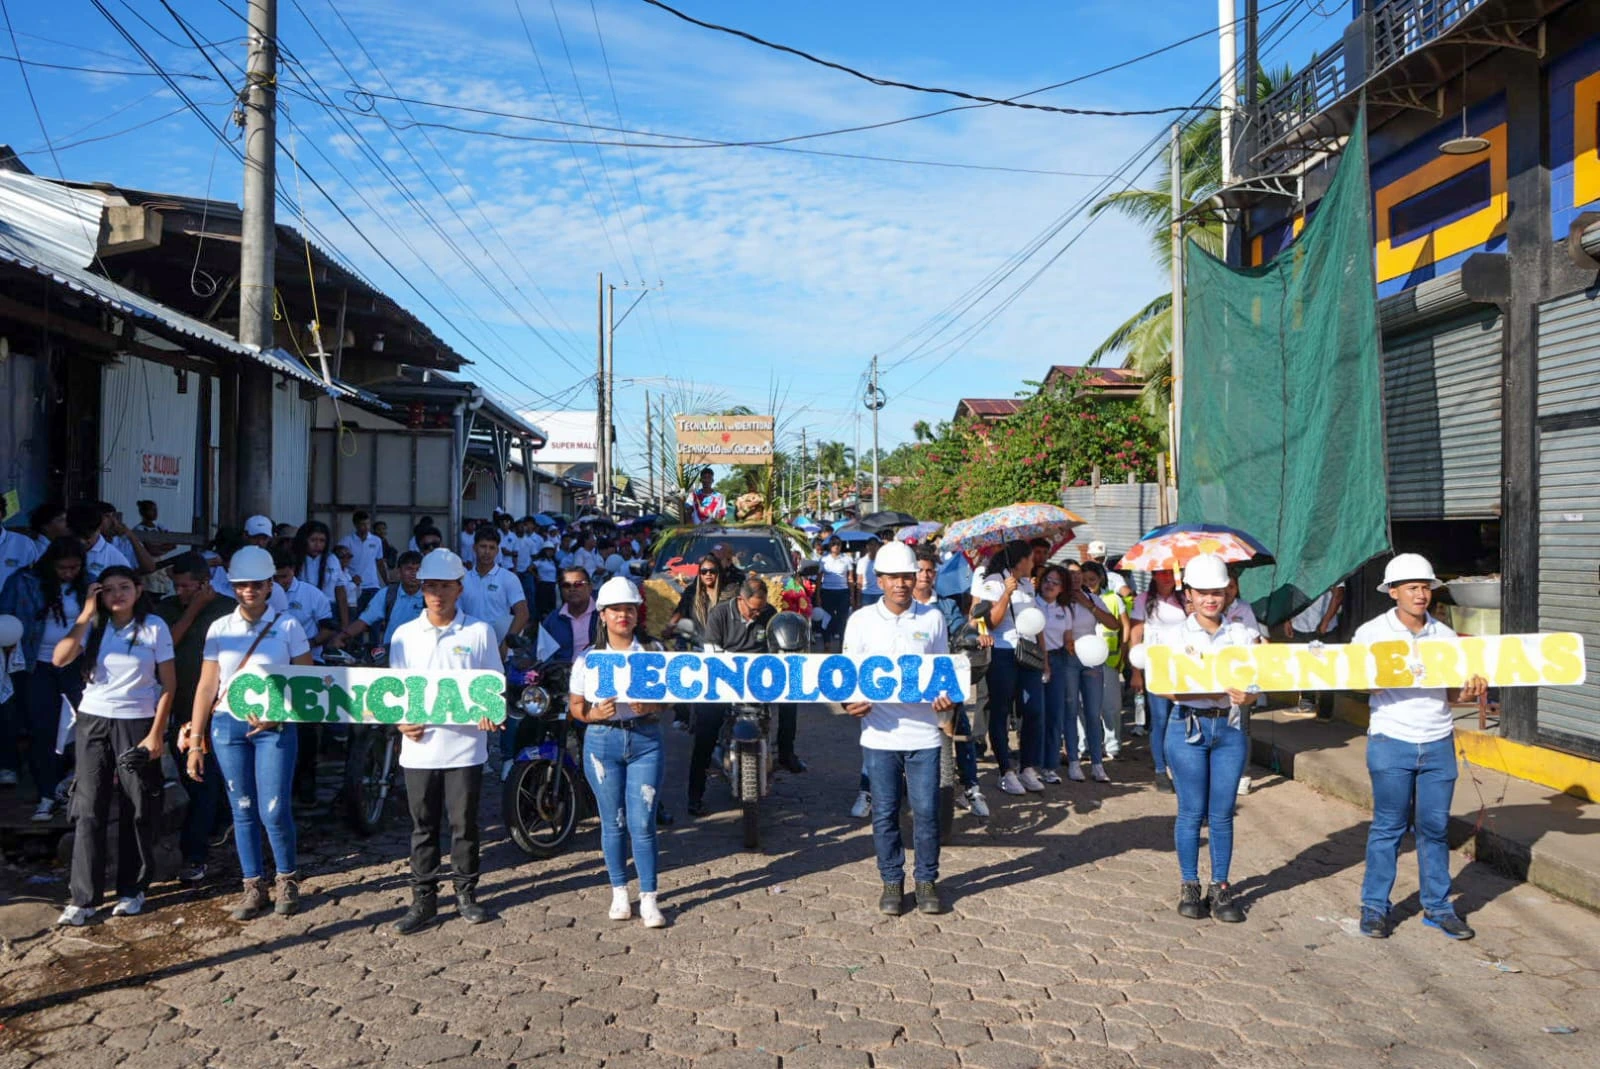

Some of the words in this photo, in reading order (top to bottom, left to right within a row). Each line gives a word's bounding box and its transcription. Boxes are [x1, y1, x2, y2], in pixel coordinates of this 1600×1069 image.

[142, 453, 152, 474] SE
[153, 455, 180, 476] ALQUILA
[551, 441, 576, 449] SUPER
[576, 441, 598, 449] MALL
[585, 652, 965, 703] TECNOLOGIA
[1146, 632, 1583, 692] INGENIERIAS
[227, 673, 506, 723] CIENCIAS
